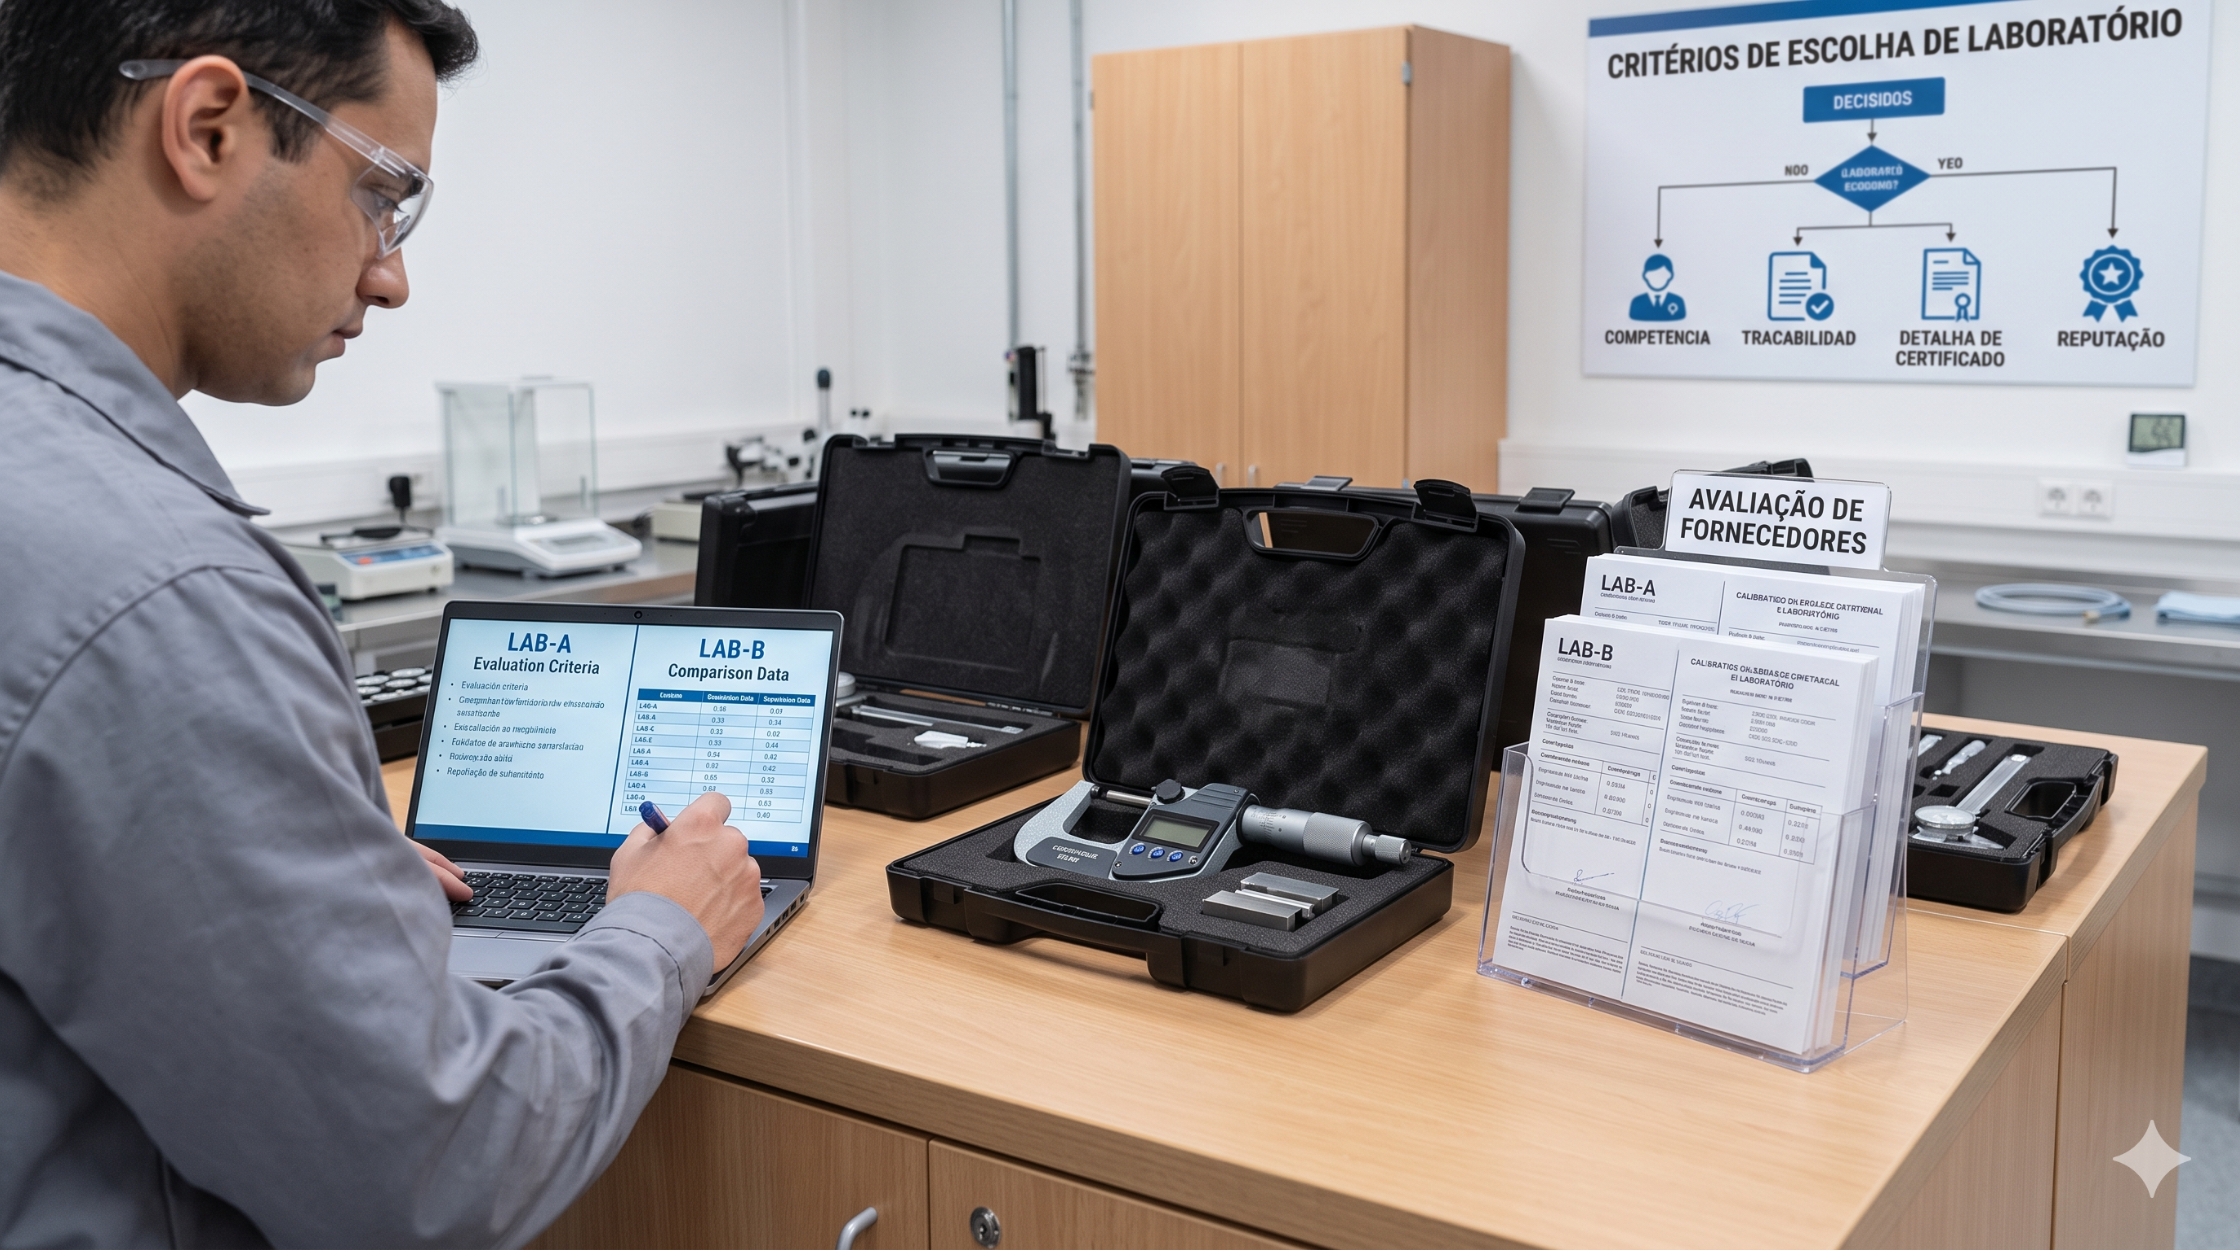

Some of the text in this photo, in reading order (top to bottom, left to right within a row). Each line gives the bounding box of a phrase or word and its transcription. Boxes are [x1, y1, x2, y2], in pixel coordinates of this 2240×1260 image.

[1608, 5, 2182, 79] CRITÉRIOS DE ESCOLHA DE LABORATÓRIO
[1833, 90, 1913, 110] DECISIDOS
[1784, 164, 1809, 176] NOO
[1937, 157, 1963, 170] YEO
[1604, 330, 1711, 345] COMPETENCIA
[1741, 330, 1857, 346] TRACABILIDAD
[1899, 330, 2003, 346] DETALHA DE
[2057, 327, 2165, 351] REPUTAÇÃO
[1895, 350, 2005, 367] CERTIFICADO
[1688, 488, 1864, 522] AVALIAÇÃO DE
[1680, 517, 1867, 554] FORNECEDORES
[1601, 574, 1656, 596] LAB-A
[507, 632, 572, 654] LAB-A
[699, 638, 766, 660] LAB-B
[1558, 637, 1613, 661] LAB-B
[473, 656, 600, 675] Evaluation Criteria
[668, 663, 790, 682] Comparison Data
